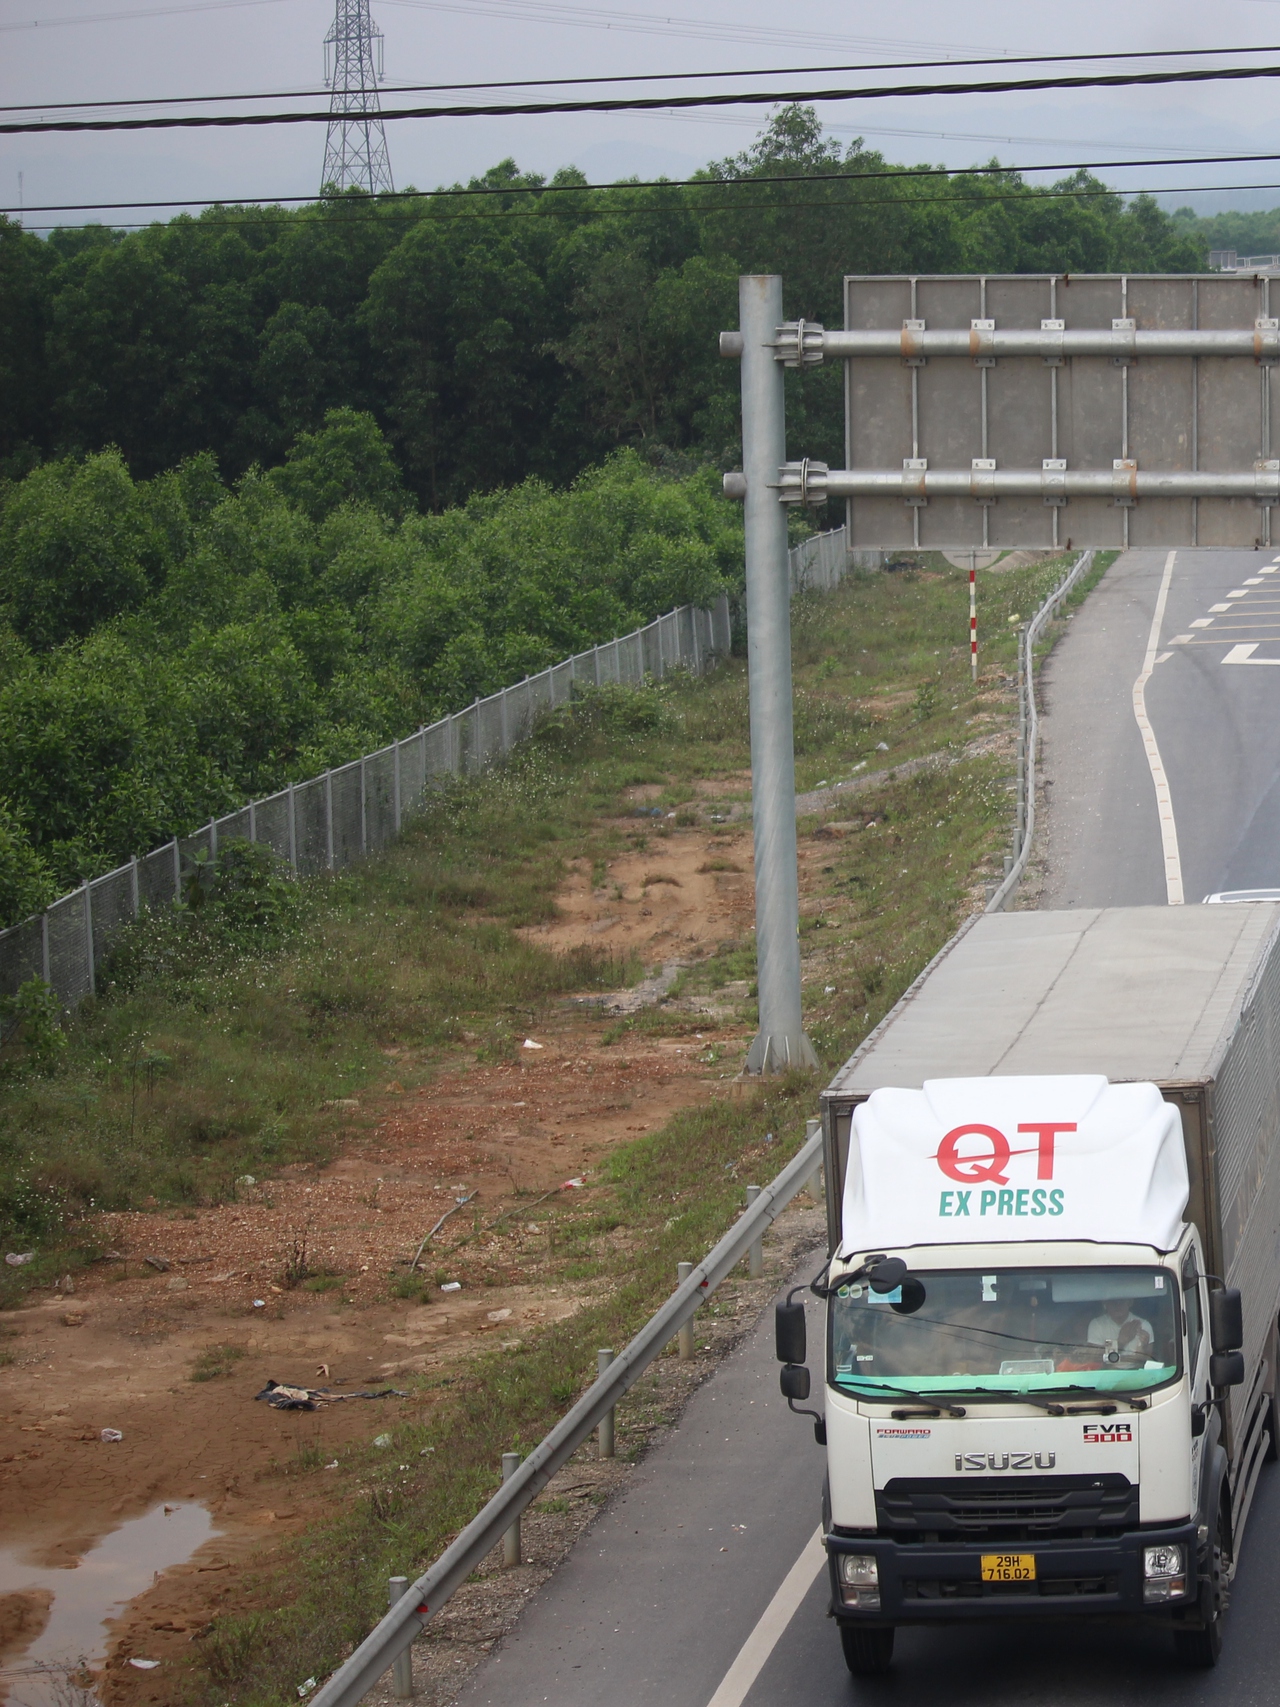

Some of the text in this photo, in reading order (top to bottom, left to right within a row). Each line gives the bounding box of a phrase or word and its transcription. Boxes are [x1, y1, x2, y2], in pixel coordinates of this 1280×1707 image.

[936, 1122, 1077, 1186] QT
[1083, 1424, 1131, 1434] FVR
[1083, 1433, 1132, 1443] 900
[954, 1450, 1056, 1471] ISUZU
[996, 1556, 1020, 1567] 29H
[987, 1568, 1030, 1580] 716.02
